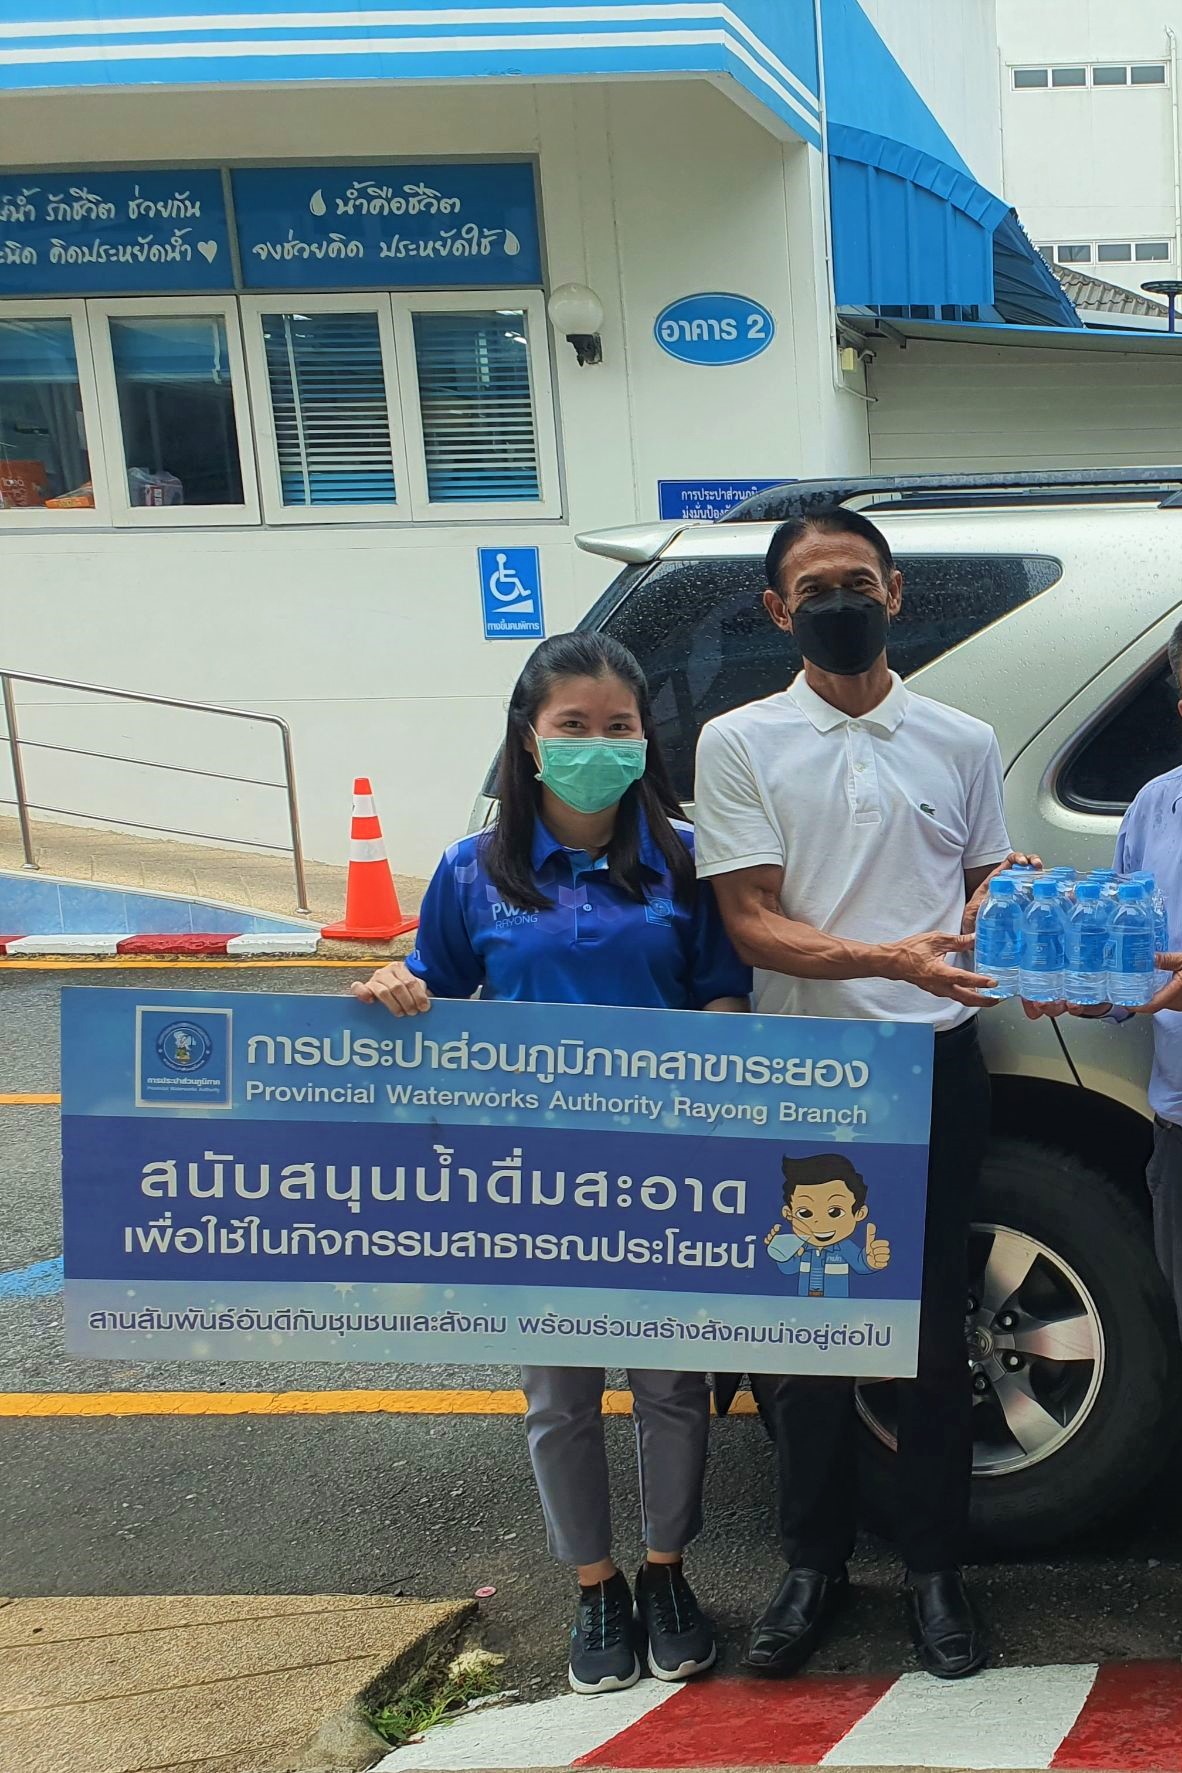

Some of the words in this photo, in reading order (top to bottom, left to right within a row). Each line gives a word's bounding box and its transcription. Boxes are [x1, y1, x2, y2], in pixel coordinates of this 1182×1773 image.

[46, 187, 116, 222] รักชีวิต
[128, 185, 201, 220] ช่วยกัน
[336, 181, 461, 216] น้ำคือชีวิต
[252, 229, 364, 261] จงช่วยคิด
[379, 223, 503, 259] ประหยัดใช้
[661, 318, 738, 343] อาคาร
[746, 314, 766, 339] 2
[491, 901, 540, 921] PW
[495, 913, 539, 931] RAYONG
[246, 1029, 870, 1089] การประปาส่วนภูมิภาคสาขาระยอง
[246, 1080, 376, 1105] Provincial
[386, 1083, 540, 1110] Waterworks
[548, 1089, 663, 1120] Authority
[673, 1096, 768, 1126] Rayong
[778, 1101, 868, 1125] Branch
[140, 1144, 748, 1215] สนับสนุนน้ำดื่มสะอาด
[124, 1211, 758, 1270] เพื่อใช้ในกิจกรรมสาธารณประโยชน์
[88, 1306, 508, 1337] สานสัมพันธ์อันดีกับชุมชนและสังคม
[518, 1312, 893, 1350] พร้อมร่วมสร้างสังคมน่าอยู่ต่อไป
